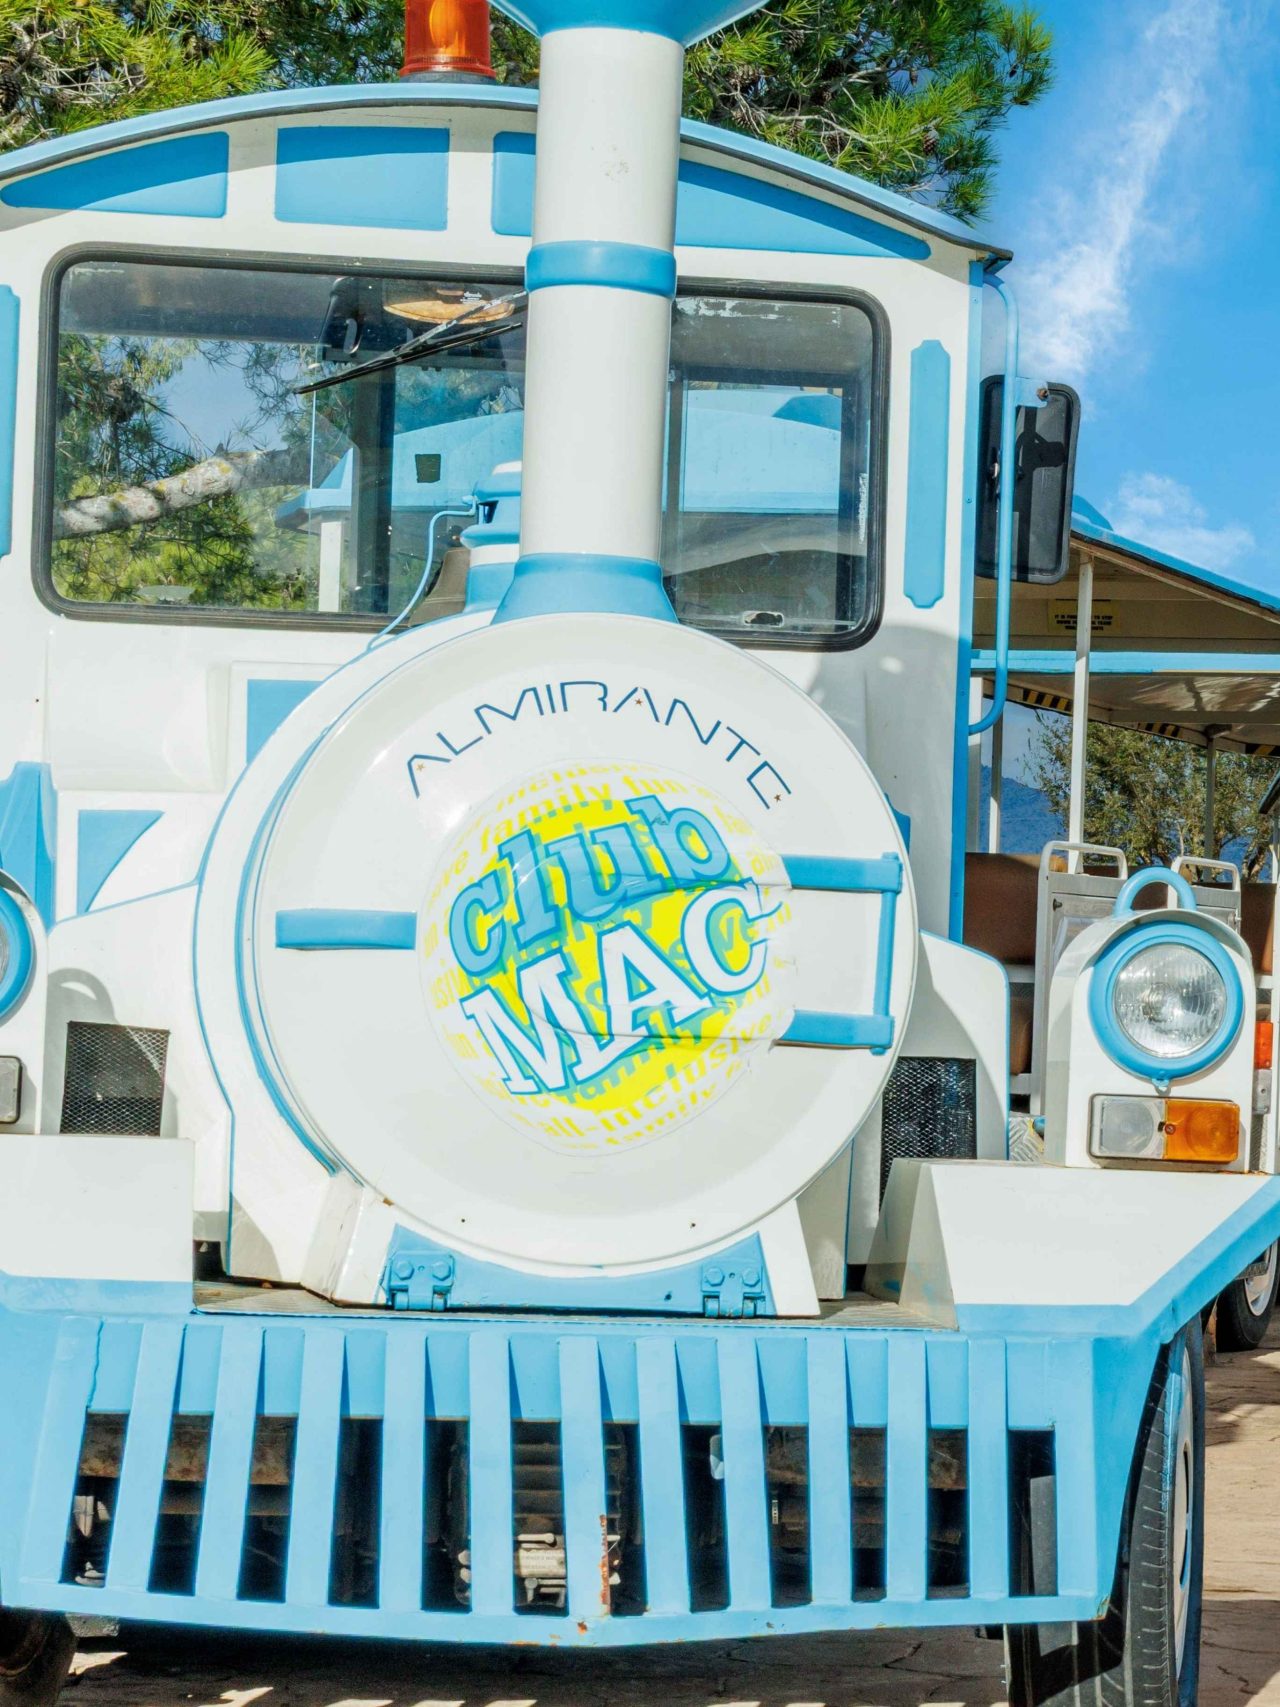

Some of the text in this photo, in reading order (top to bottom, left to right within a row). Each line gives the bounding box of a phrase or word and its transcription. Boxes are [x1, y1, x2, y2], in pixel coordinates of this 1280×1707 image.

[407, 680, 792, 810] ALMIRANTE
[480, 782, 614, 857] family
[448, 793, 731, 978] club
[459, 876, 783, 1096] MAC
